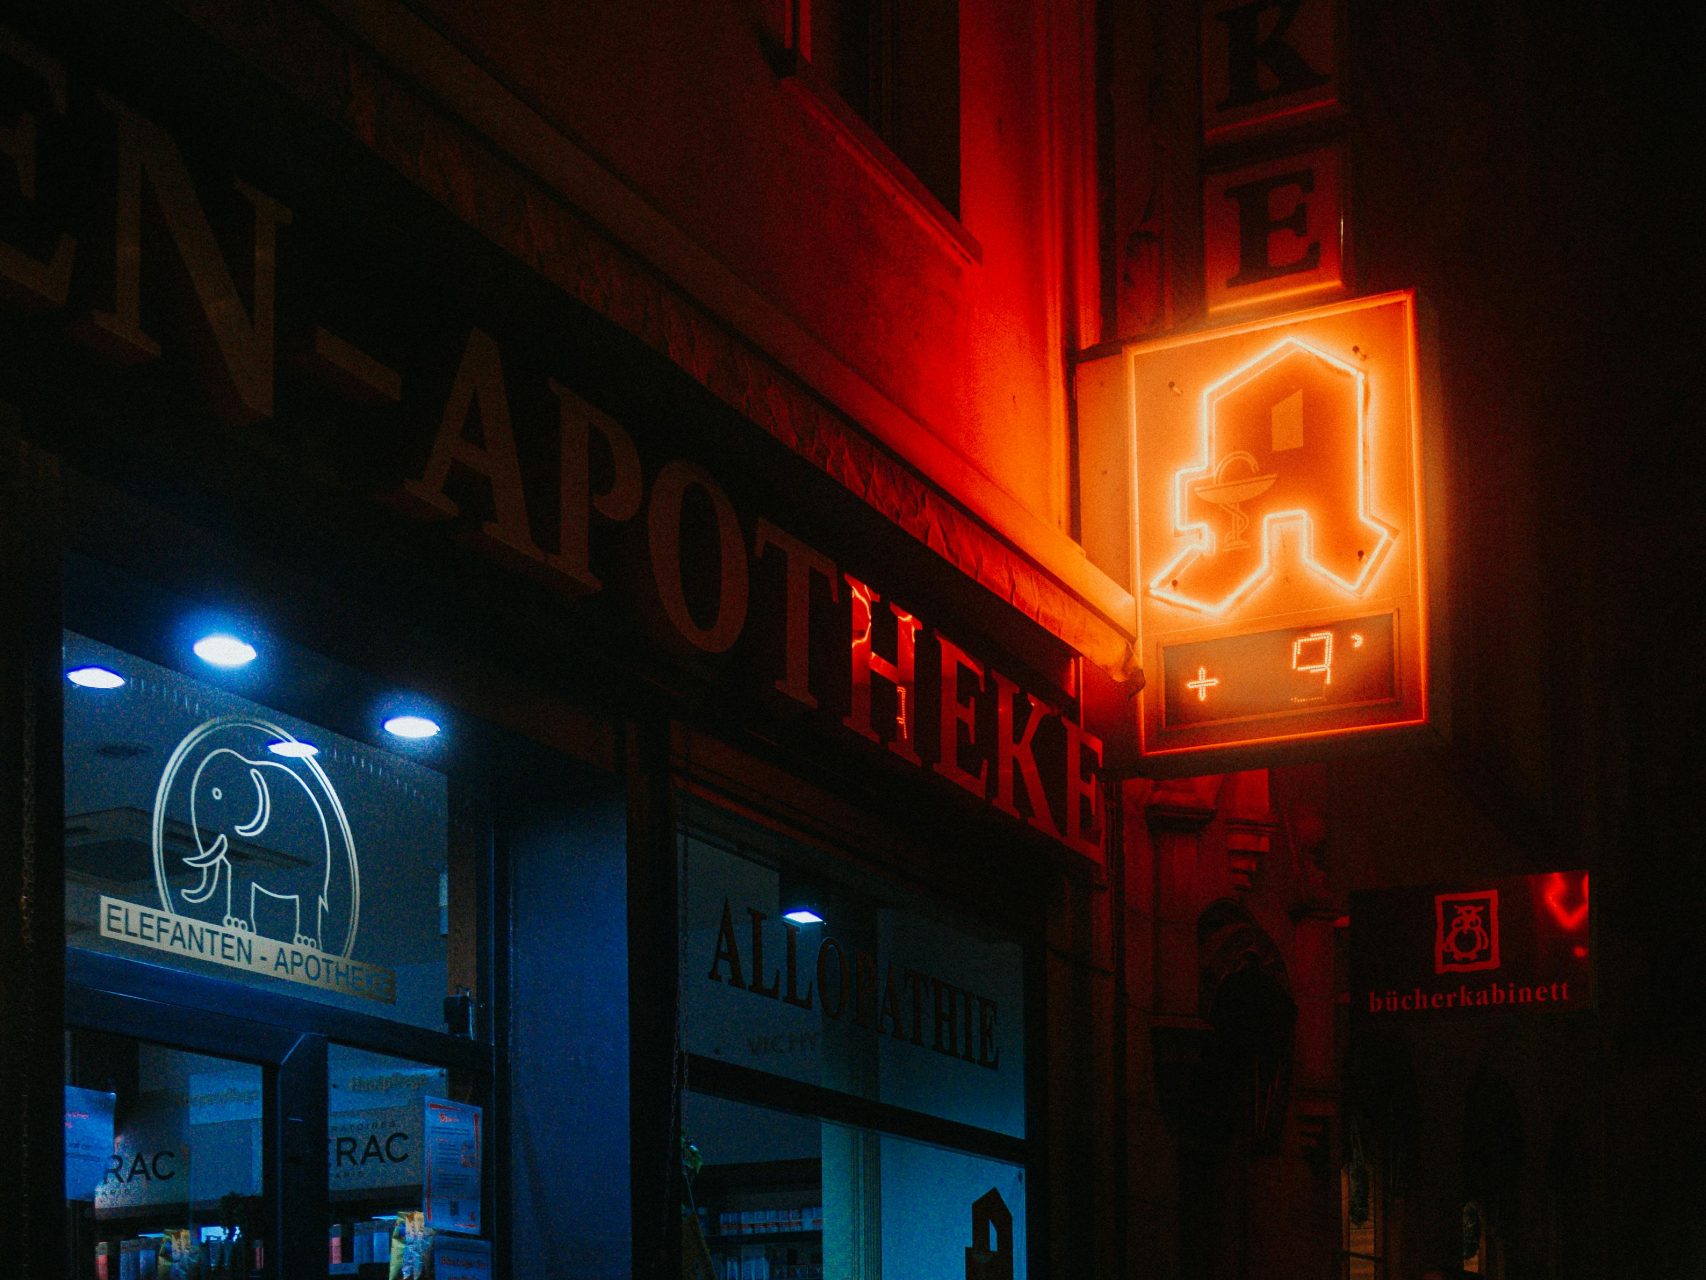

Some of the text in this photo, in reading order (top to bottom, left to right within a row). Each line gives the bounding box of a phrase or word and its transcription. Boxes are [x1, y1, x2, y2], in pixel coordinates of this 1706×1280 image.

[106, 903, 252, 966] ELEFANTEN
[709, 898, 1000, 1071] ALLOPATHIE
[1368, 981, 1570, 1015] bücherkabinett
[329, 1131, 409, 1167] RAC
